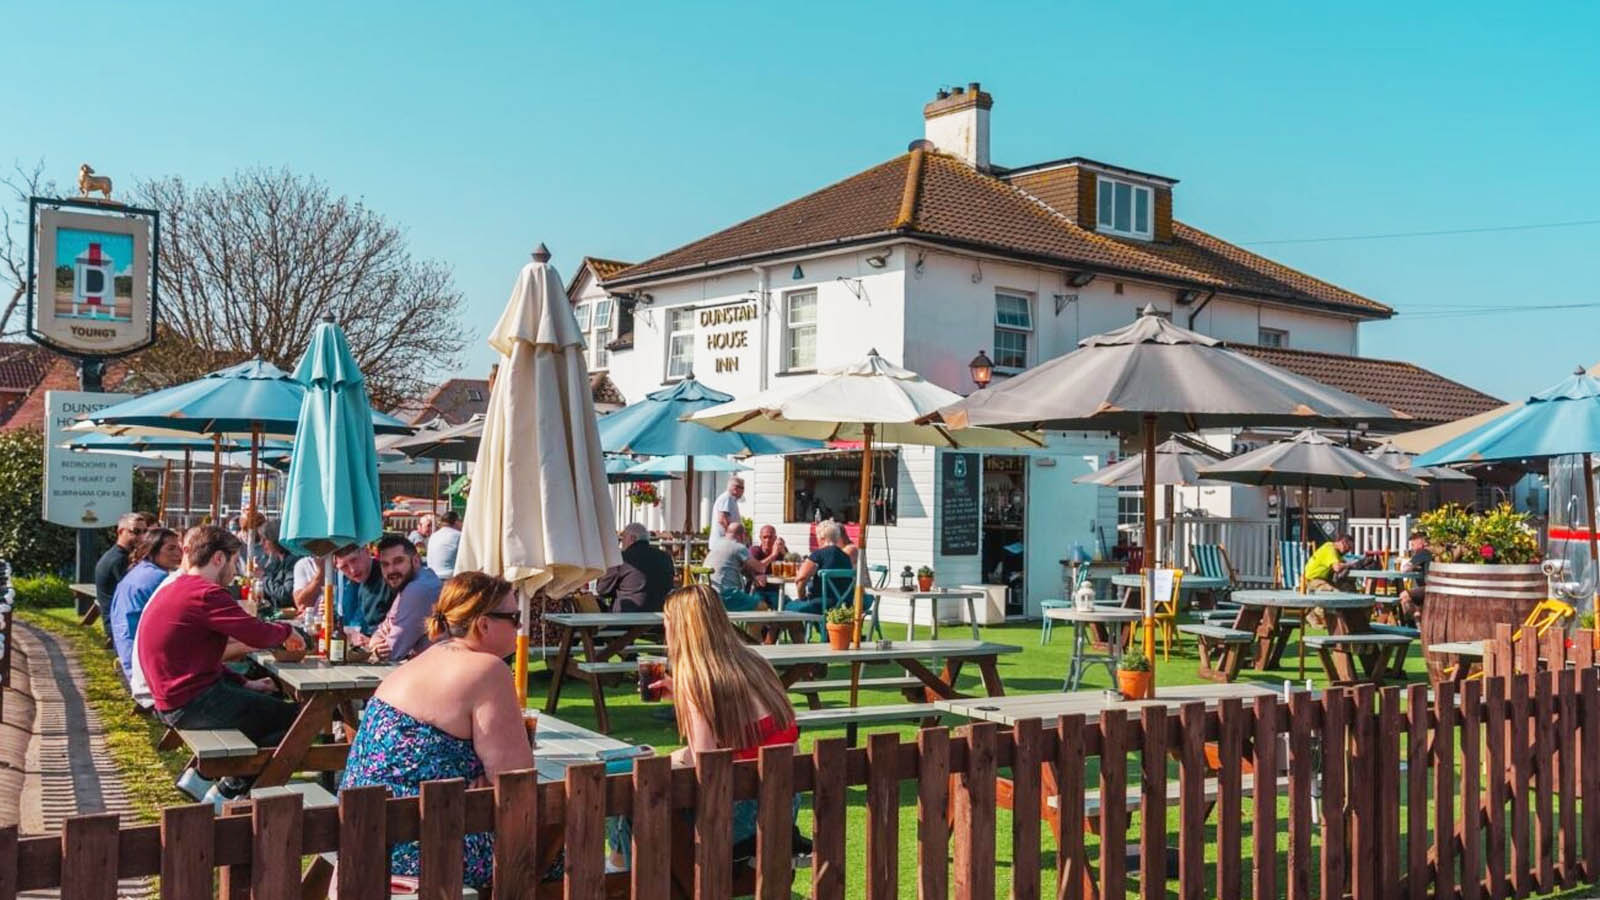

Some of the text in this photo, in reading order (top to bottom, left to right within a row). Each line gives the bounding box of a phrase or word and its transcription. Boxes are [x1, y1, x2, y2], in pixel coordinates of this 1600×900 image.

[700, 304, 757, 327] DUNSTAN
[707, 330, 748, 350] HOUSE
[715, 356, 739, 373] INN
[62, 403, 111, 413] DUNST
